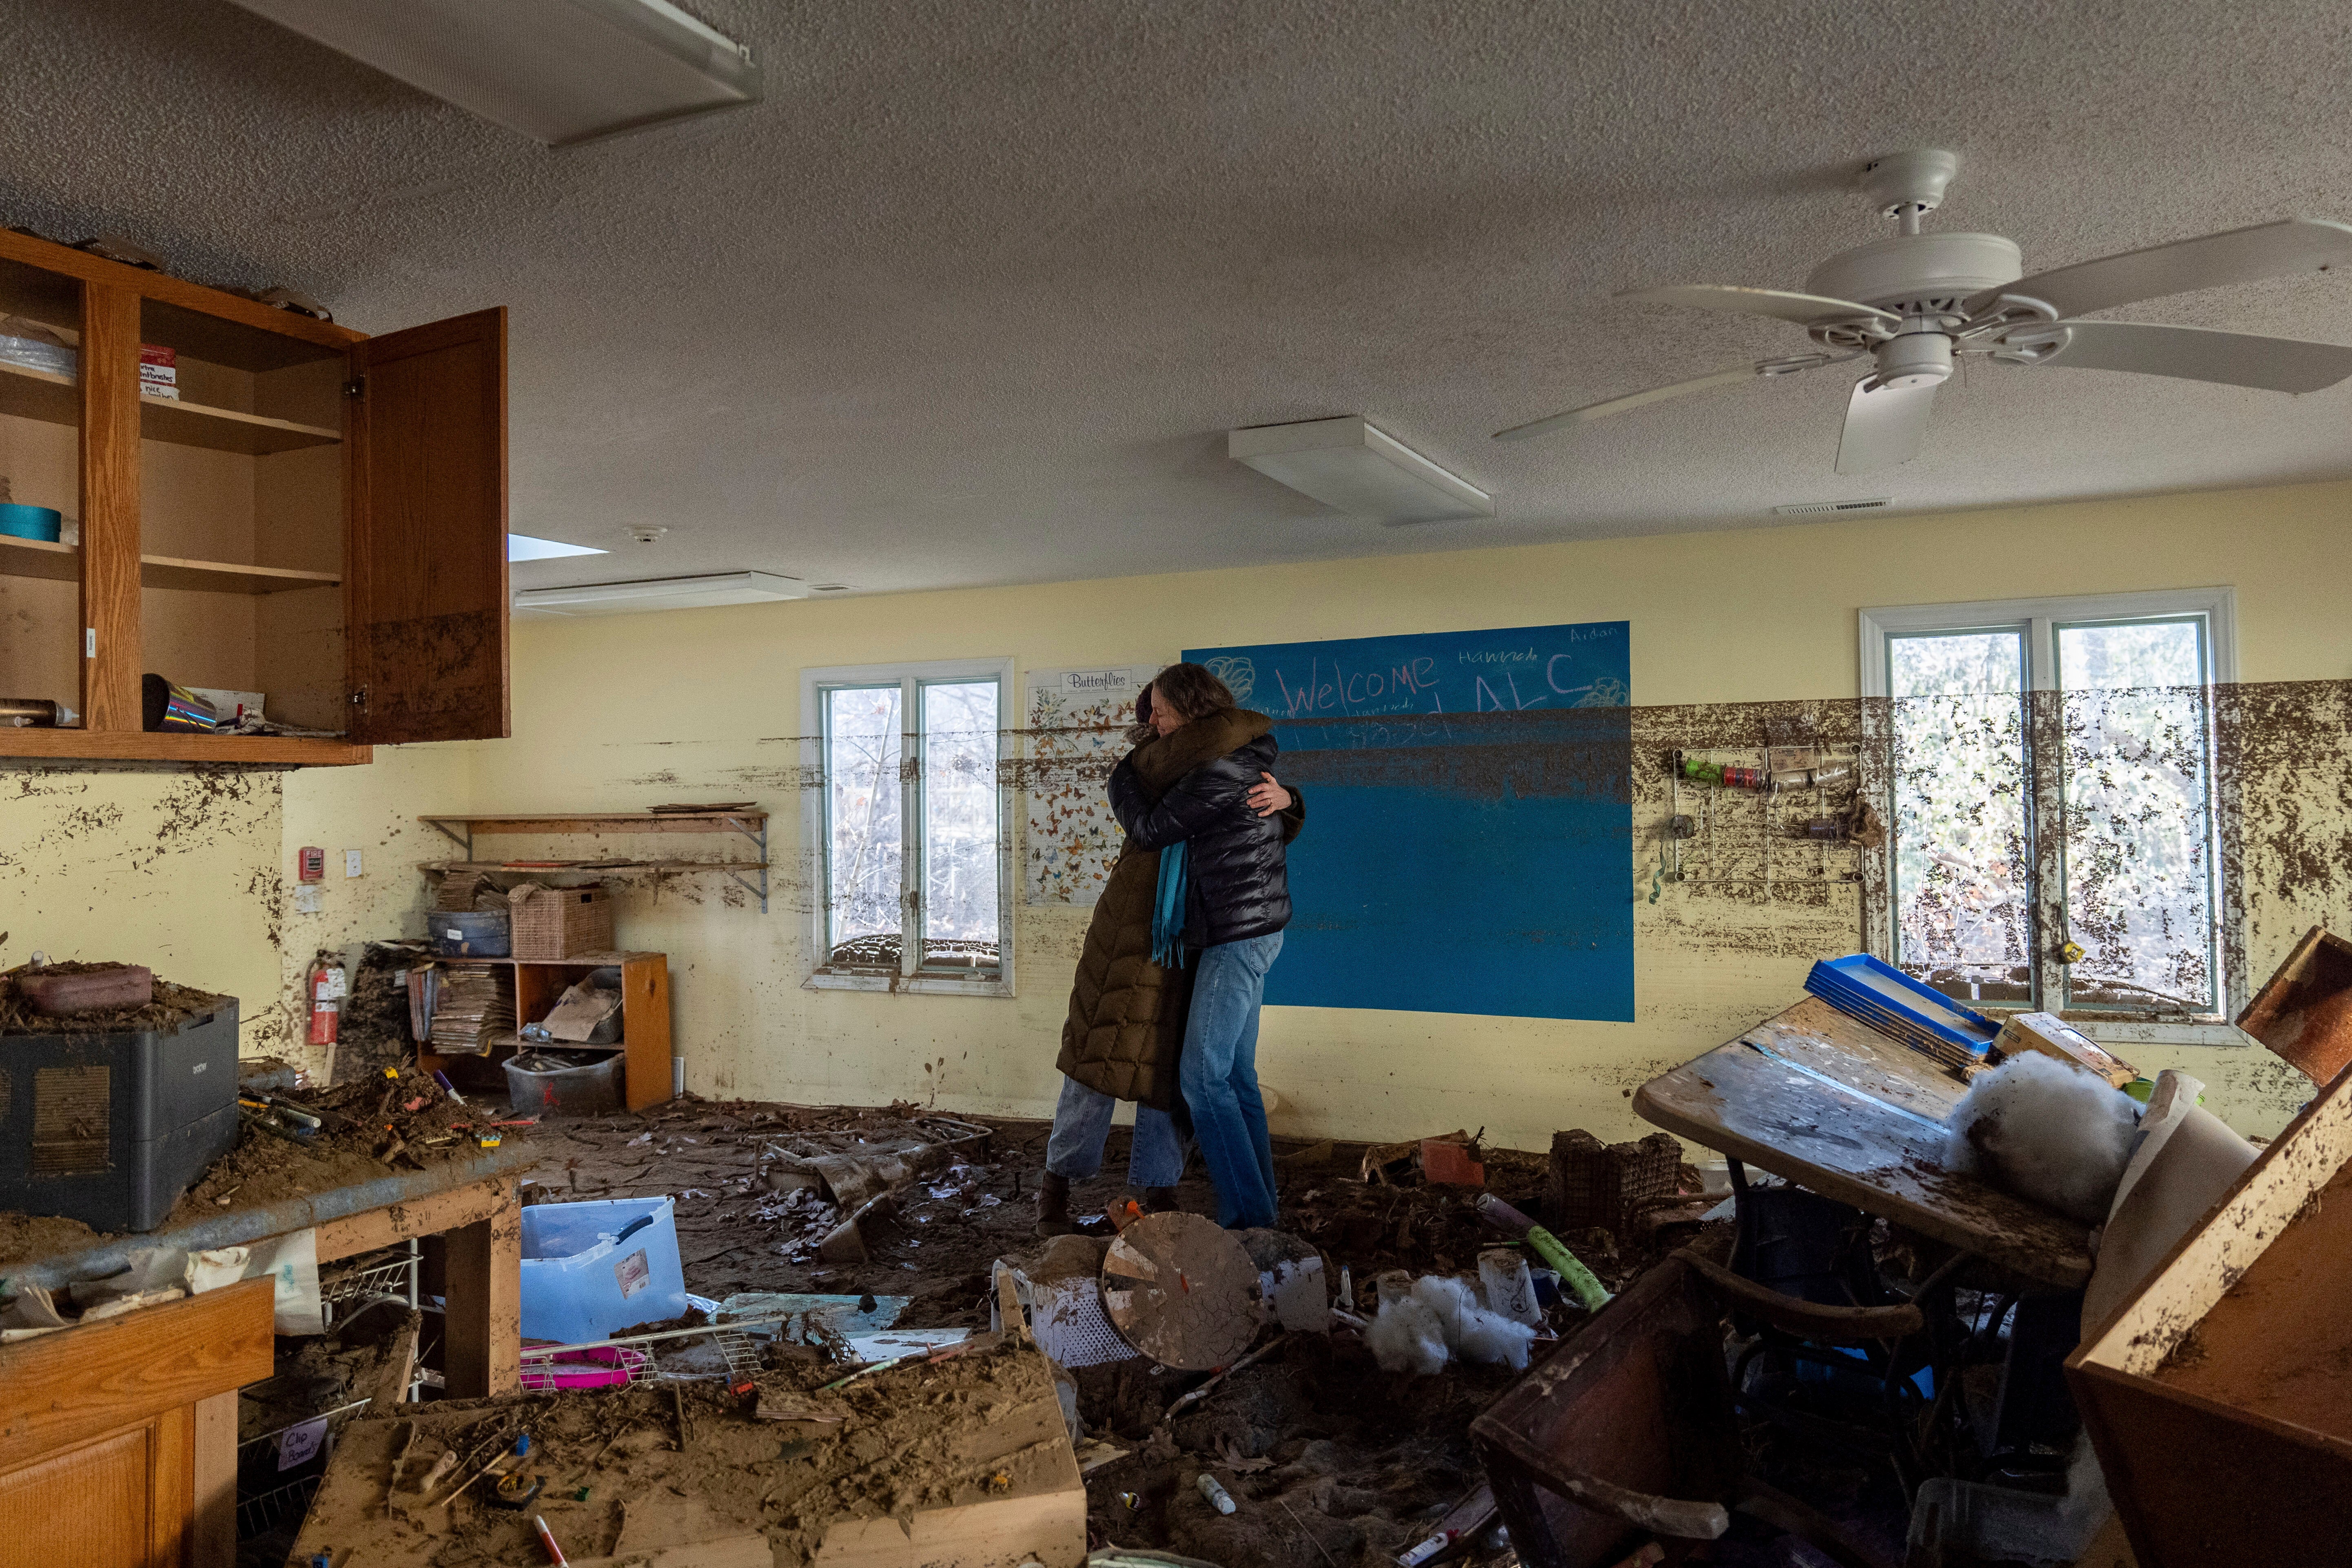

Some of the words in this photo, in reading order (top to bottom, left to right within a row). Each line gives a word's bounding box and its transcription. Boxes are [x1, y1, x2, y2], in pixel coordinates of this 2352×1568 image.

[145, 385, 160, 393] nice
[1571, 627, 1618, 643] Aidan
[1067, 672, 1125, 690] Butterflies
[1476, 654, 1593, 712] ALC
[193, 1062, 207, 1074] brother
[286, 1432, 308, 1447] Clip
